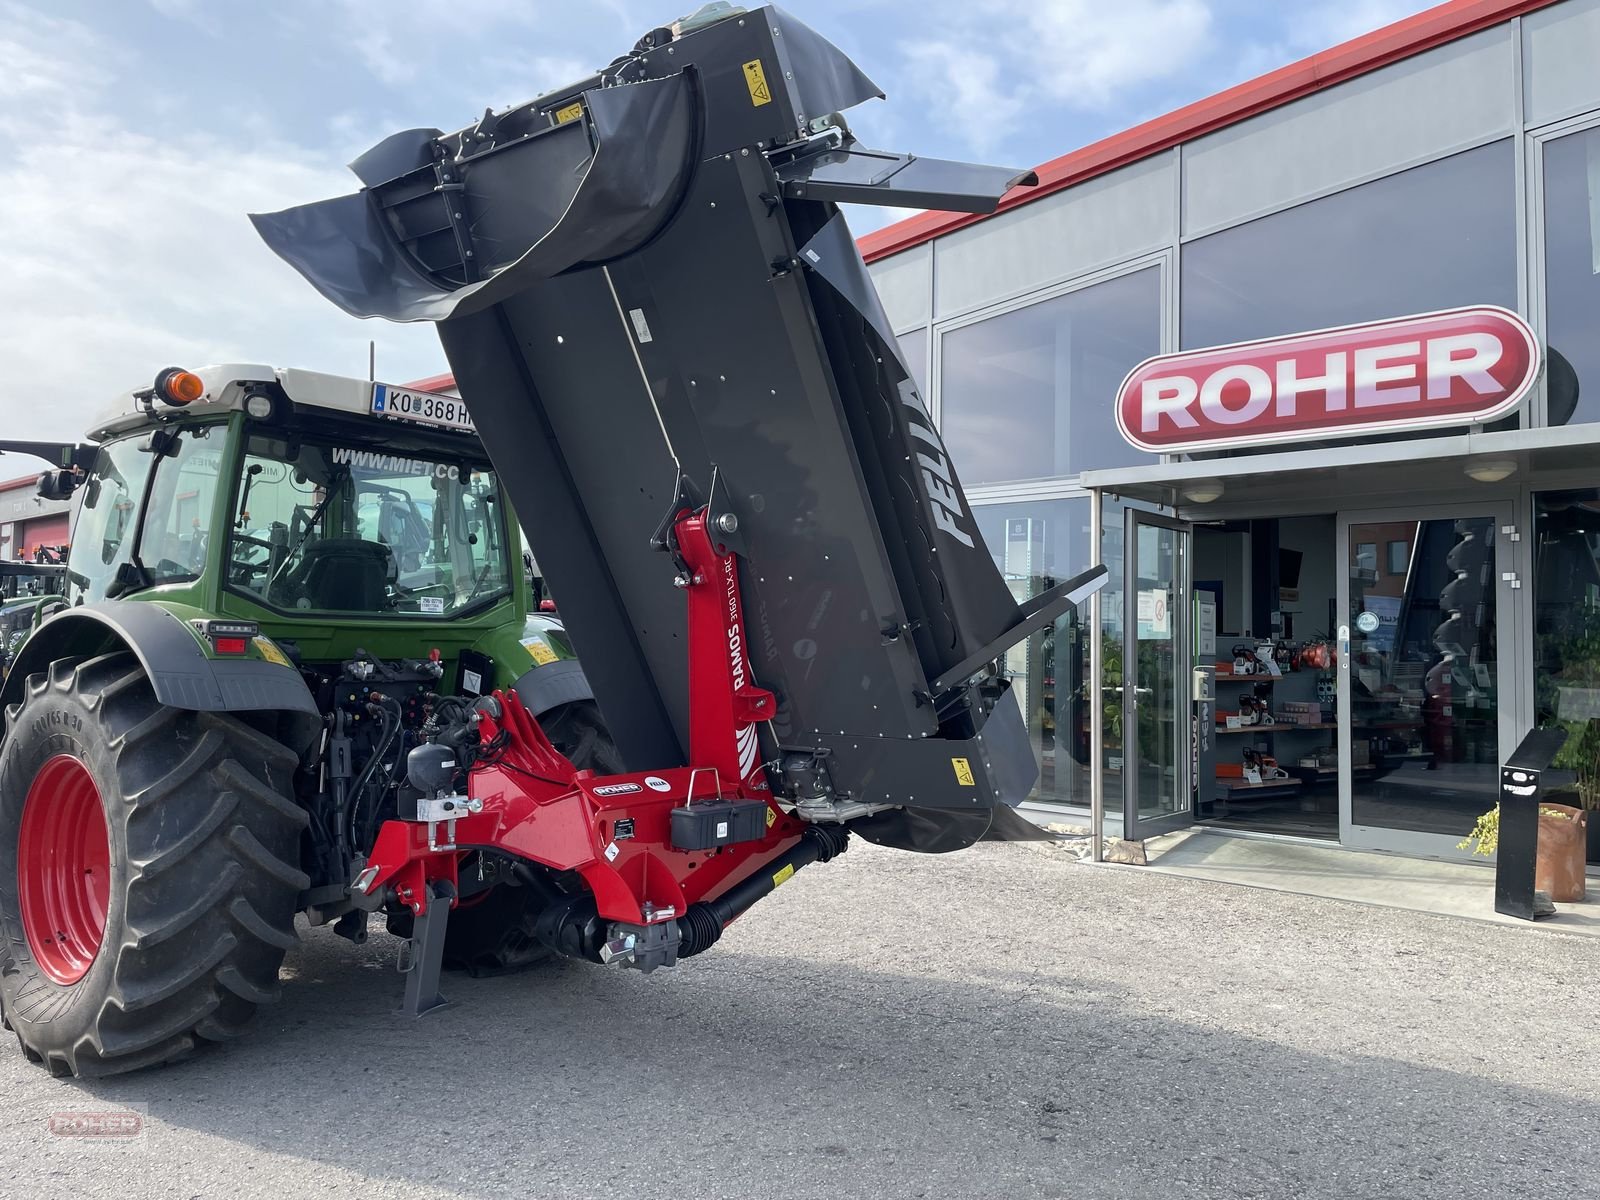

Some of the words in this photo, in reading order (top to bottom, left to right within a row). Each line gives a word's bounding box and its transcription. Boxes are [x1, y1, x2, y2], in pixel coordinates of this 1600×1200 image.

[1141, 332, 1506, 433] ROHER
[390, 391, 411, 413] KO
[424, 399, 455, 421] 368
[332, 447, 459, 480] WWW.MIET.CC
[897, 377, 975, 549] FELLA
[724, 556, 735, 597] TLX-RC
[728, 597, 738, 622] 3160
[728, 623, 745, 692] RAMOS
[595, 783, 640, 796] ROHER
